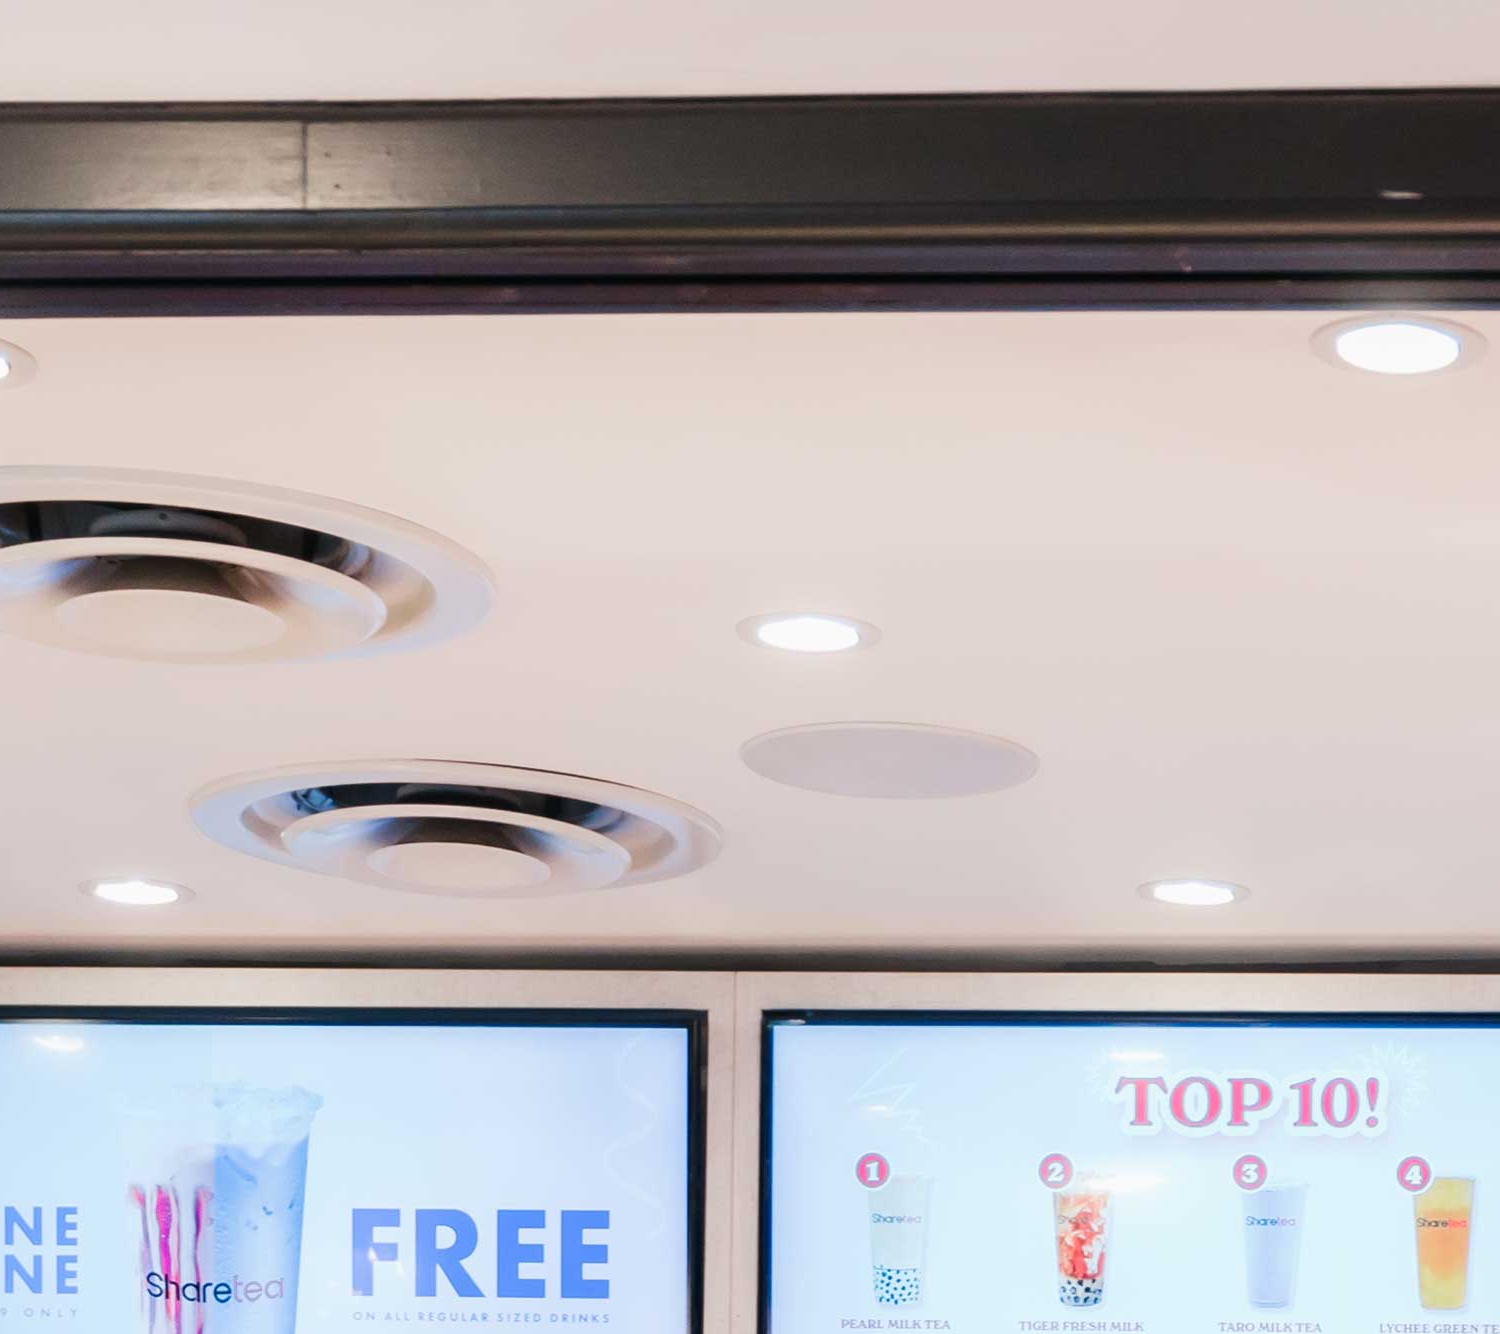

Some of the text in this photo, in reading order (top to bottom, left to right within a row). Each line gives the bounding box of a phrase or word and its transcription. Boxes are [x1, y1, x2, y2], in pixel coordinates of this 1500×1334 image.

[1115, 1076, 1380, 1127] TOP 10!
[866, 1163, 880, 1180] 1
[1047, 1163, 1065, 1181] 2
[1241, 1164, 1259, 1183] 3
[1405, 1165, 1422, 1185] 4
[872, 1213, 922, 1224] Sharetea
[1246, 1216, 1295, 1227] Sharetea
[1417, 1217, 1467, 1228] Sharetea
[352, 1209, 610, 1299] FREE
[147, 1271, 284, 1303] Sharetea
[24, 1308, 77, 1318] ONLY
[353, 1312, 610, 1323] ON ALL REGULAR SIZED DRINKS
[841, 1320, 951, 1330] PEARL MILK TEA
[1019, 1321, 1144, 1332] TIGER FRESH MILK
[1219, 1322, 1322, 1333] TARO MILK TEA
[1380, 1323, 1430, 1334] LYCHEE
[1434, 1324, 1476, 1334] GREEN
